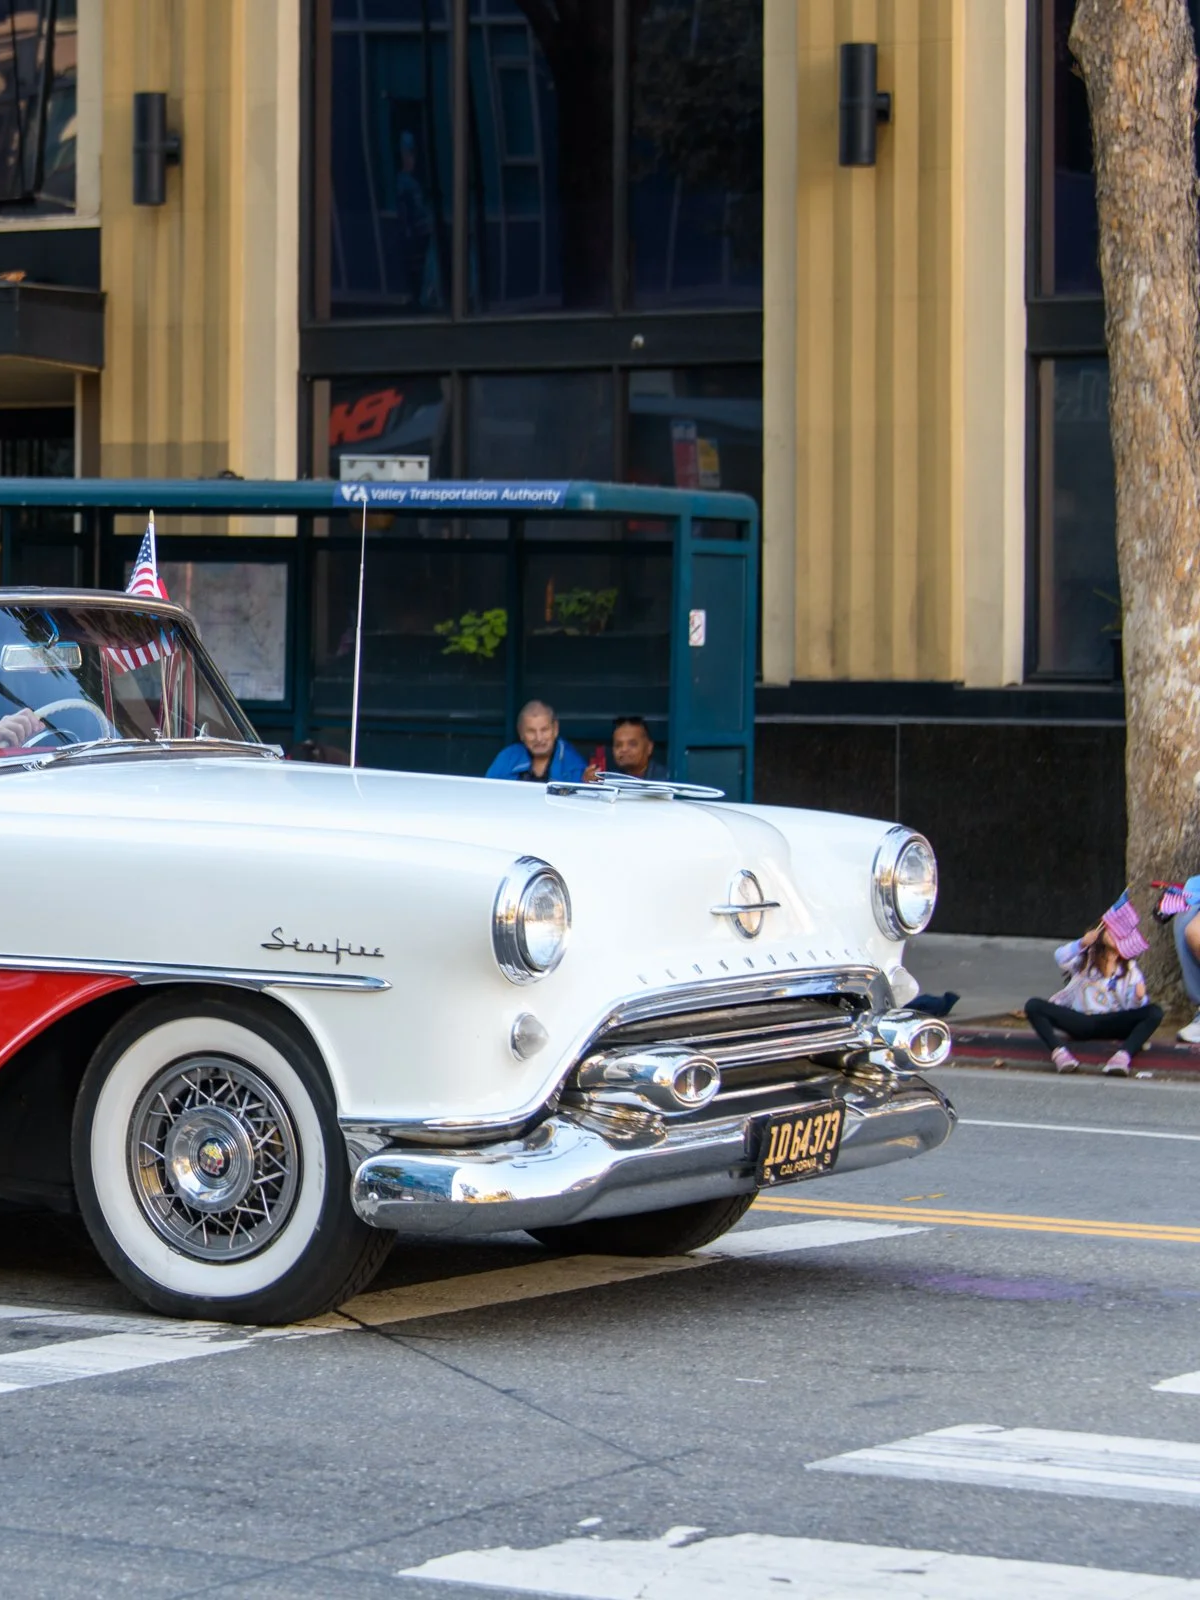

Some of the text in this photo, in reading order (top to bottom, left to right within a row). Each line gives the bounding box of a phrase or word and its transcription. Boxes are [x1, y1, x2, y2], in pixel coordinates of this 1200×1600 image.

[371, 487, 406, 503] Valley
[410, 487, 498, 502] Transportation
[501, 487, 560, 504] Authority
[780, 1157, 817, 1176] CALIFORNIA
